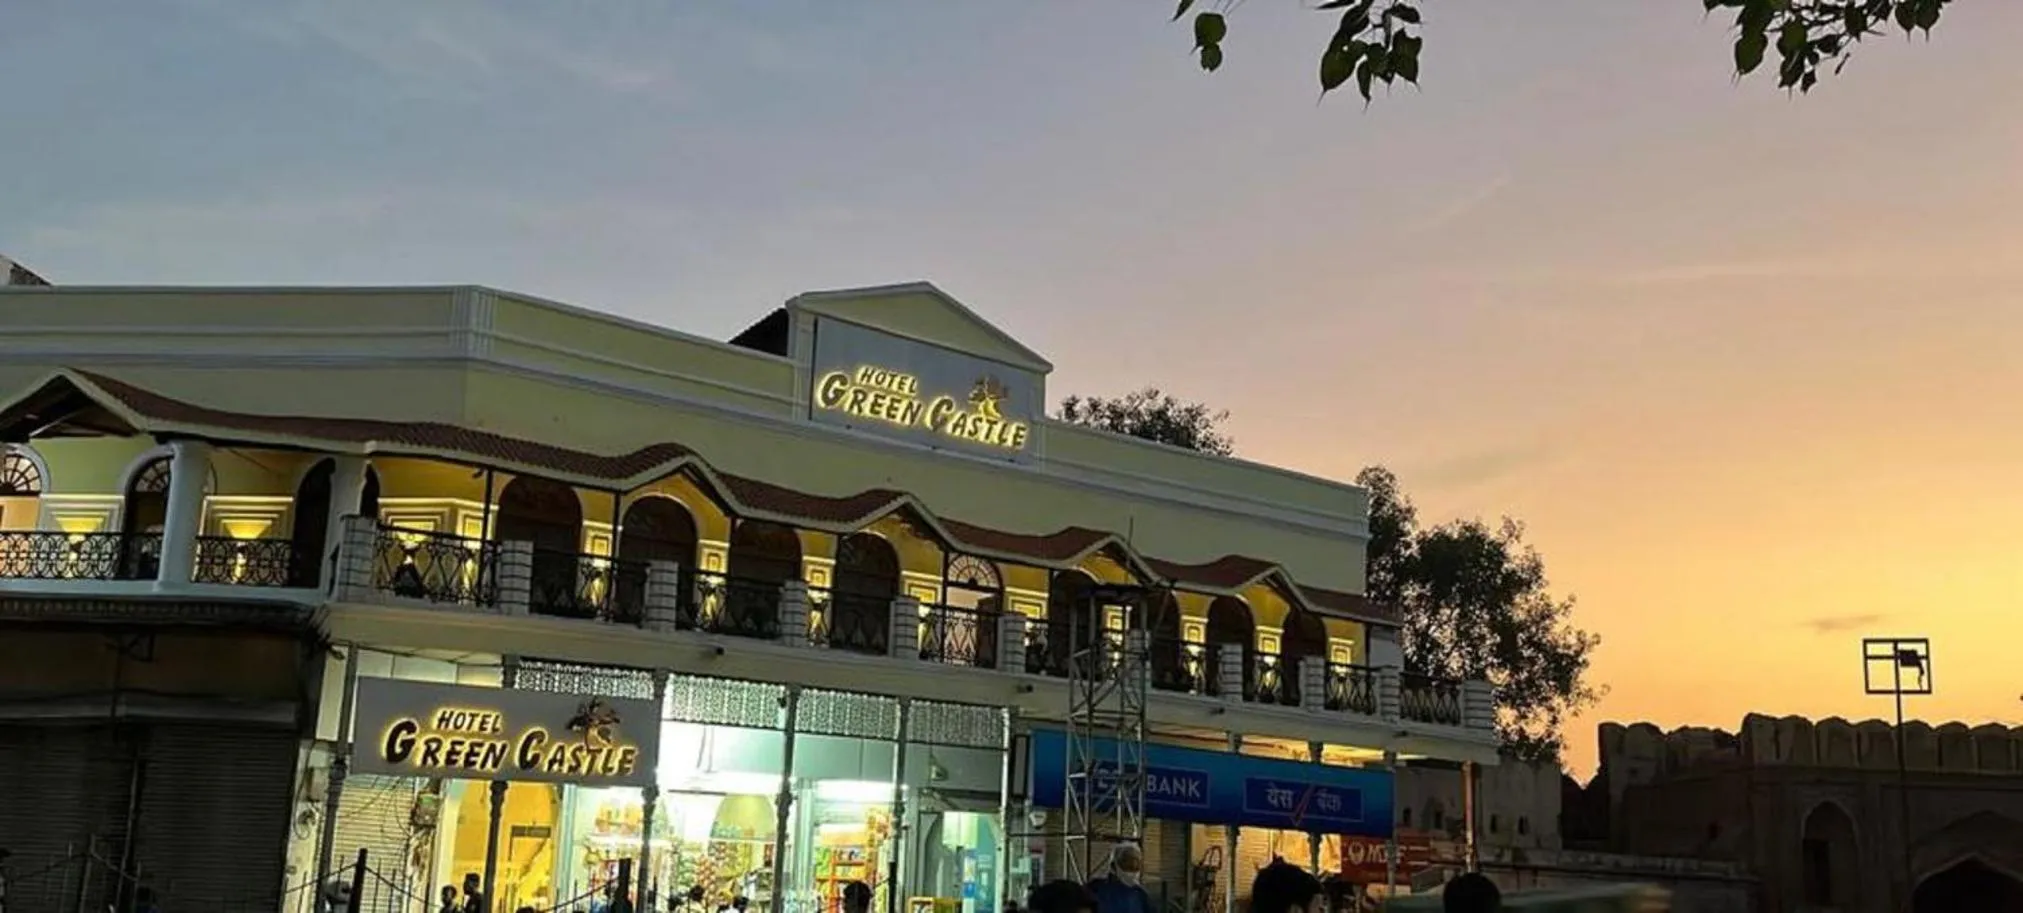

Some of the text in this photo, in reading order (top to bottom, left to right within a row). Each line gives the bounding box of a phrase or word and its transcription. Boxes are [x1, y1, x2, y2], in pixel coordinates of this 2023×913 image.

[859, 366, 918, 395] HOTEL
[820, 373, 1028, 448] GREEN CASTLE
[437, 709, 502, 734] HOTEL
[385, 720, 636, 776] GREEN CASTLE
[1147, 773, 1202, 798] BANK
